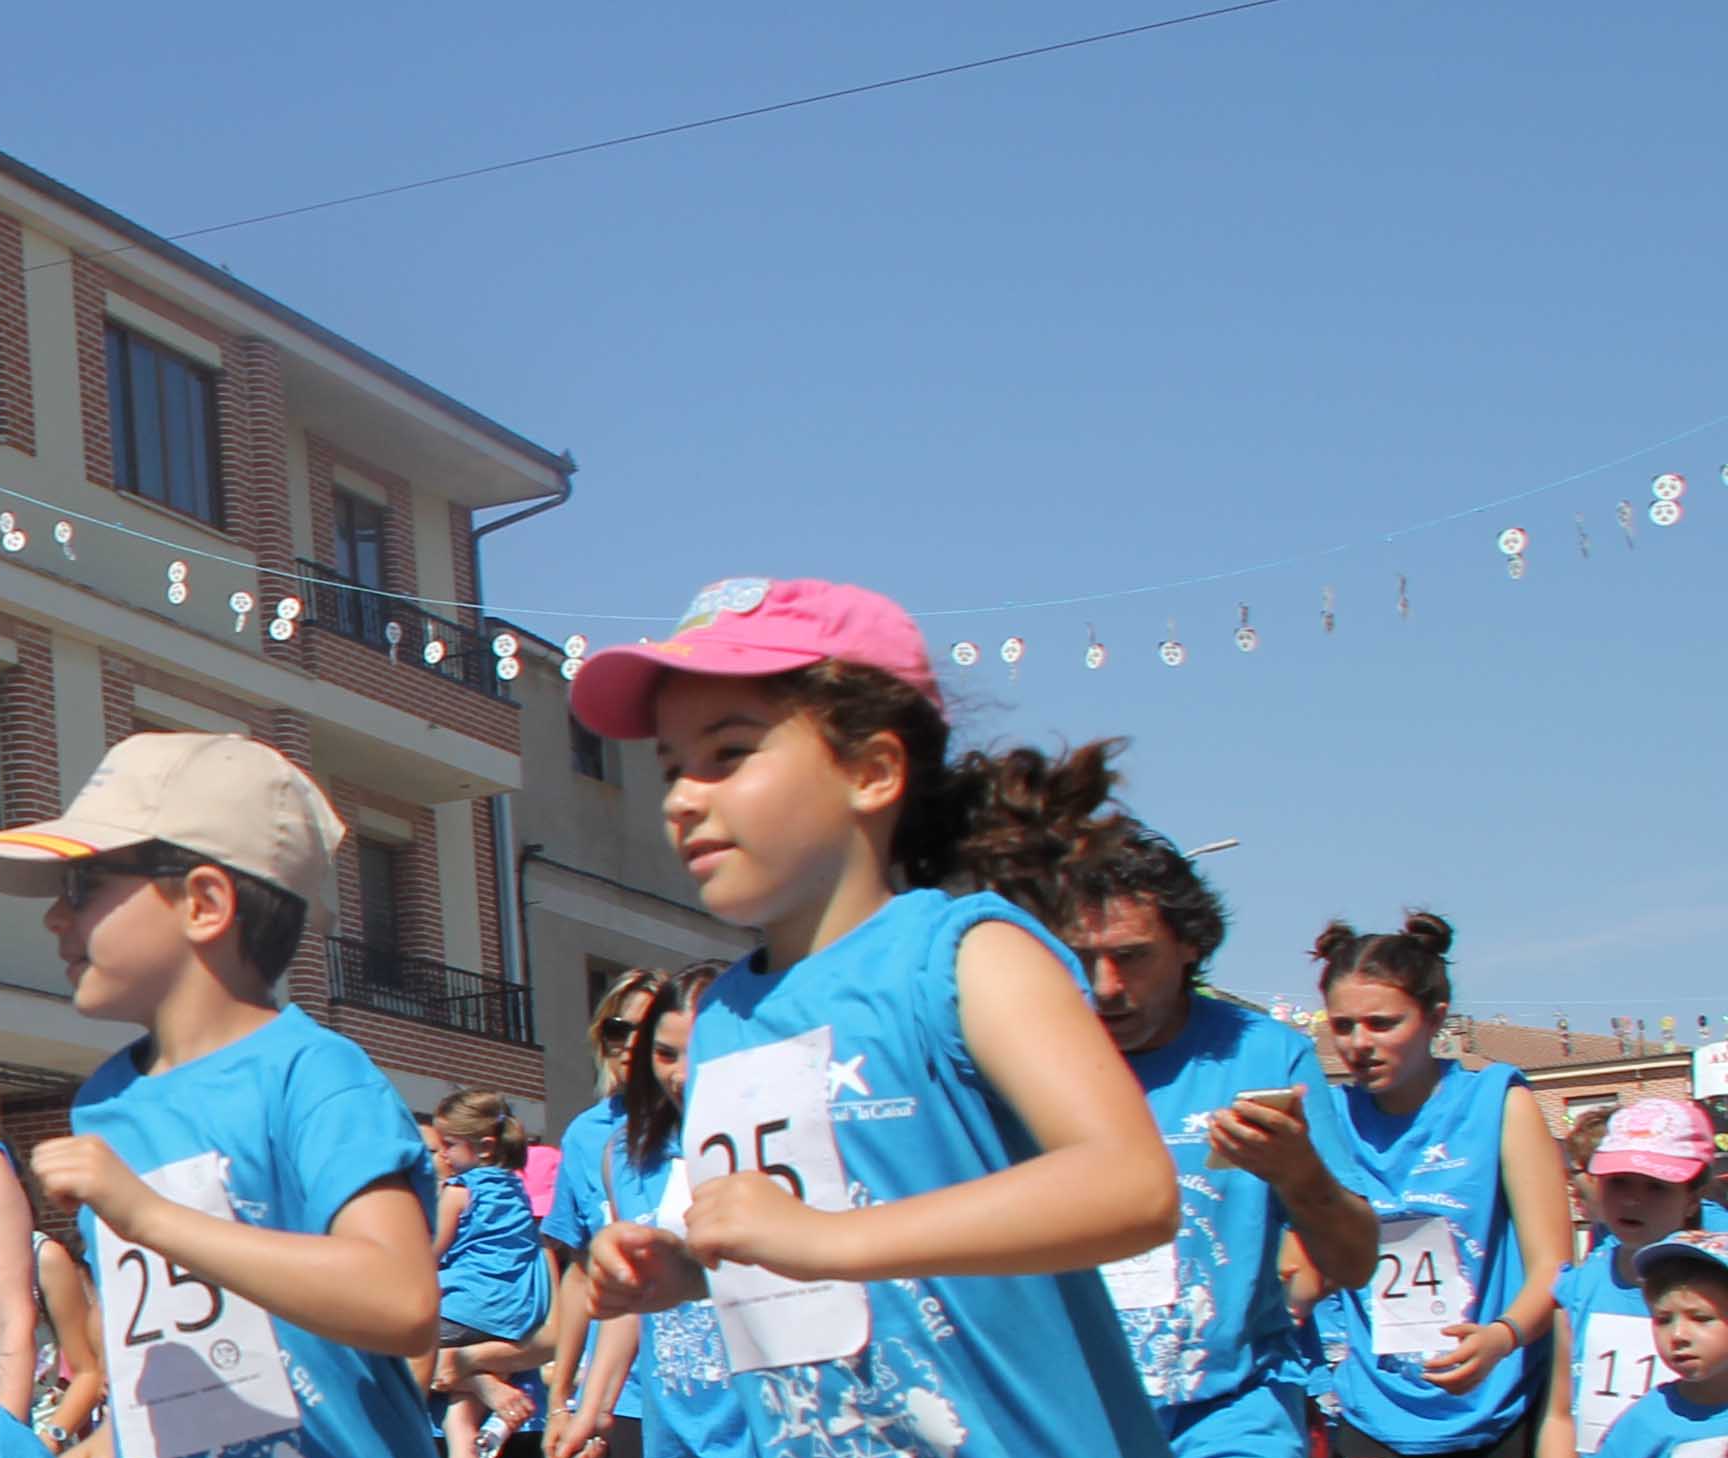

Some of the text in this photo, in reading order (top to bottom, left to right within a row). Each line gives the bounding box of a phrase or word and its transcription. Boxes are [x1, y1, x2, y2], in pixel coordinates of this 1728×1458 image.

[118, 1248, 225, 1347] 25
[1378, 1250, 1442, 1299] 24
[1594, 1349, 1658, 1399] 11
